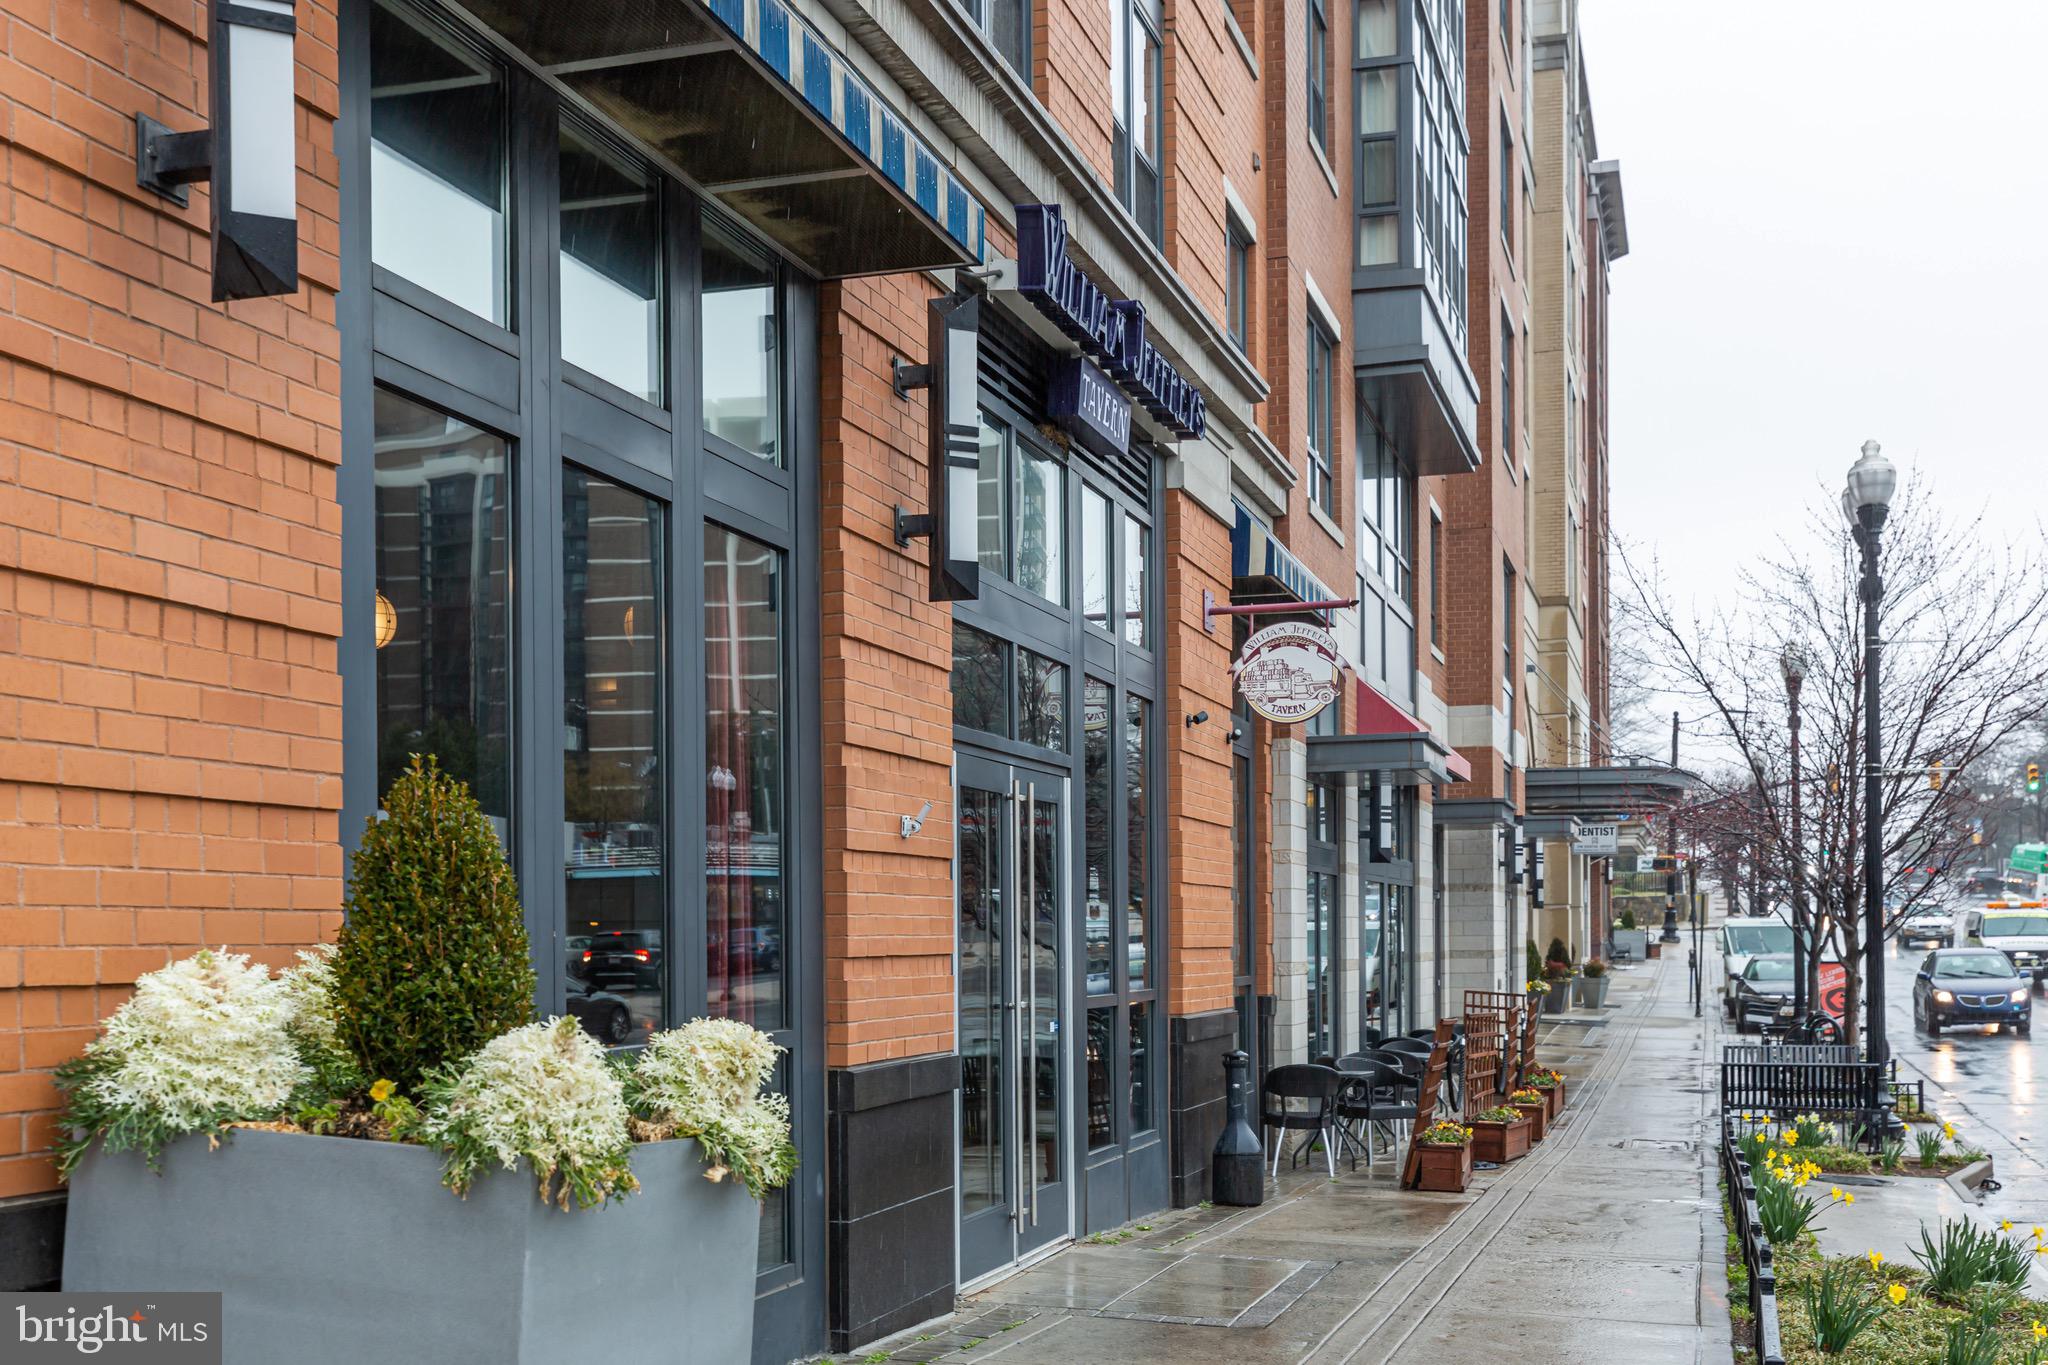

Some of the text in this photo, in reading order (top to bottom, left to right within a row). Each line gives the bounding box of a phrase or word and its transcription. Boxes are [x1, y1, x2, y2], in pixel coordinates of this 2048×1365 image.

[1042, 205, 1206, 440] WILLIAM JEFFREYS
[1082, 374, 1129, 443] TAVERN
[1245, 624, 1334, 650] WILLIAM JEFFREYS
[1271, 703, 1307, 714] TAVERN
